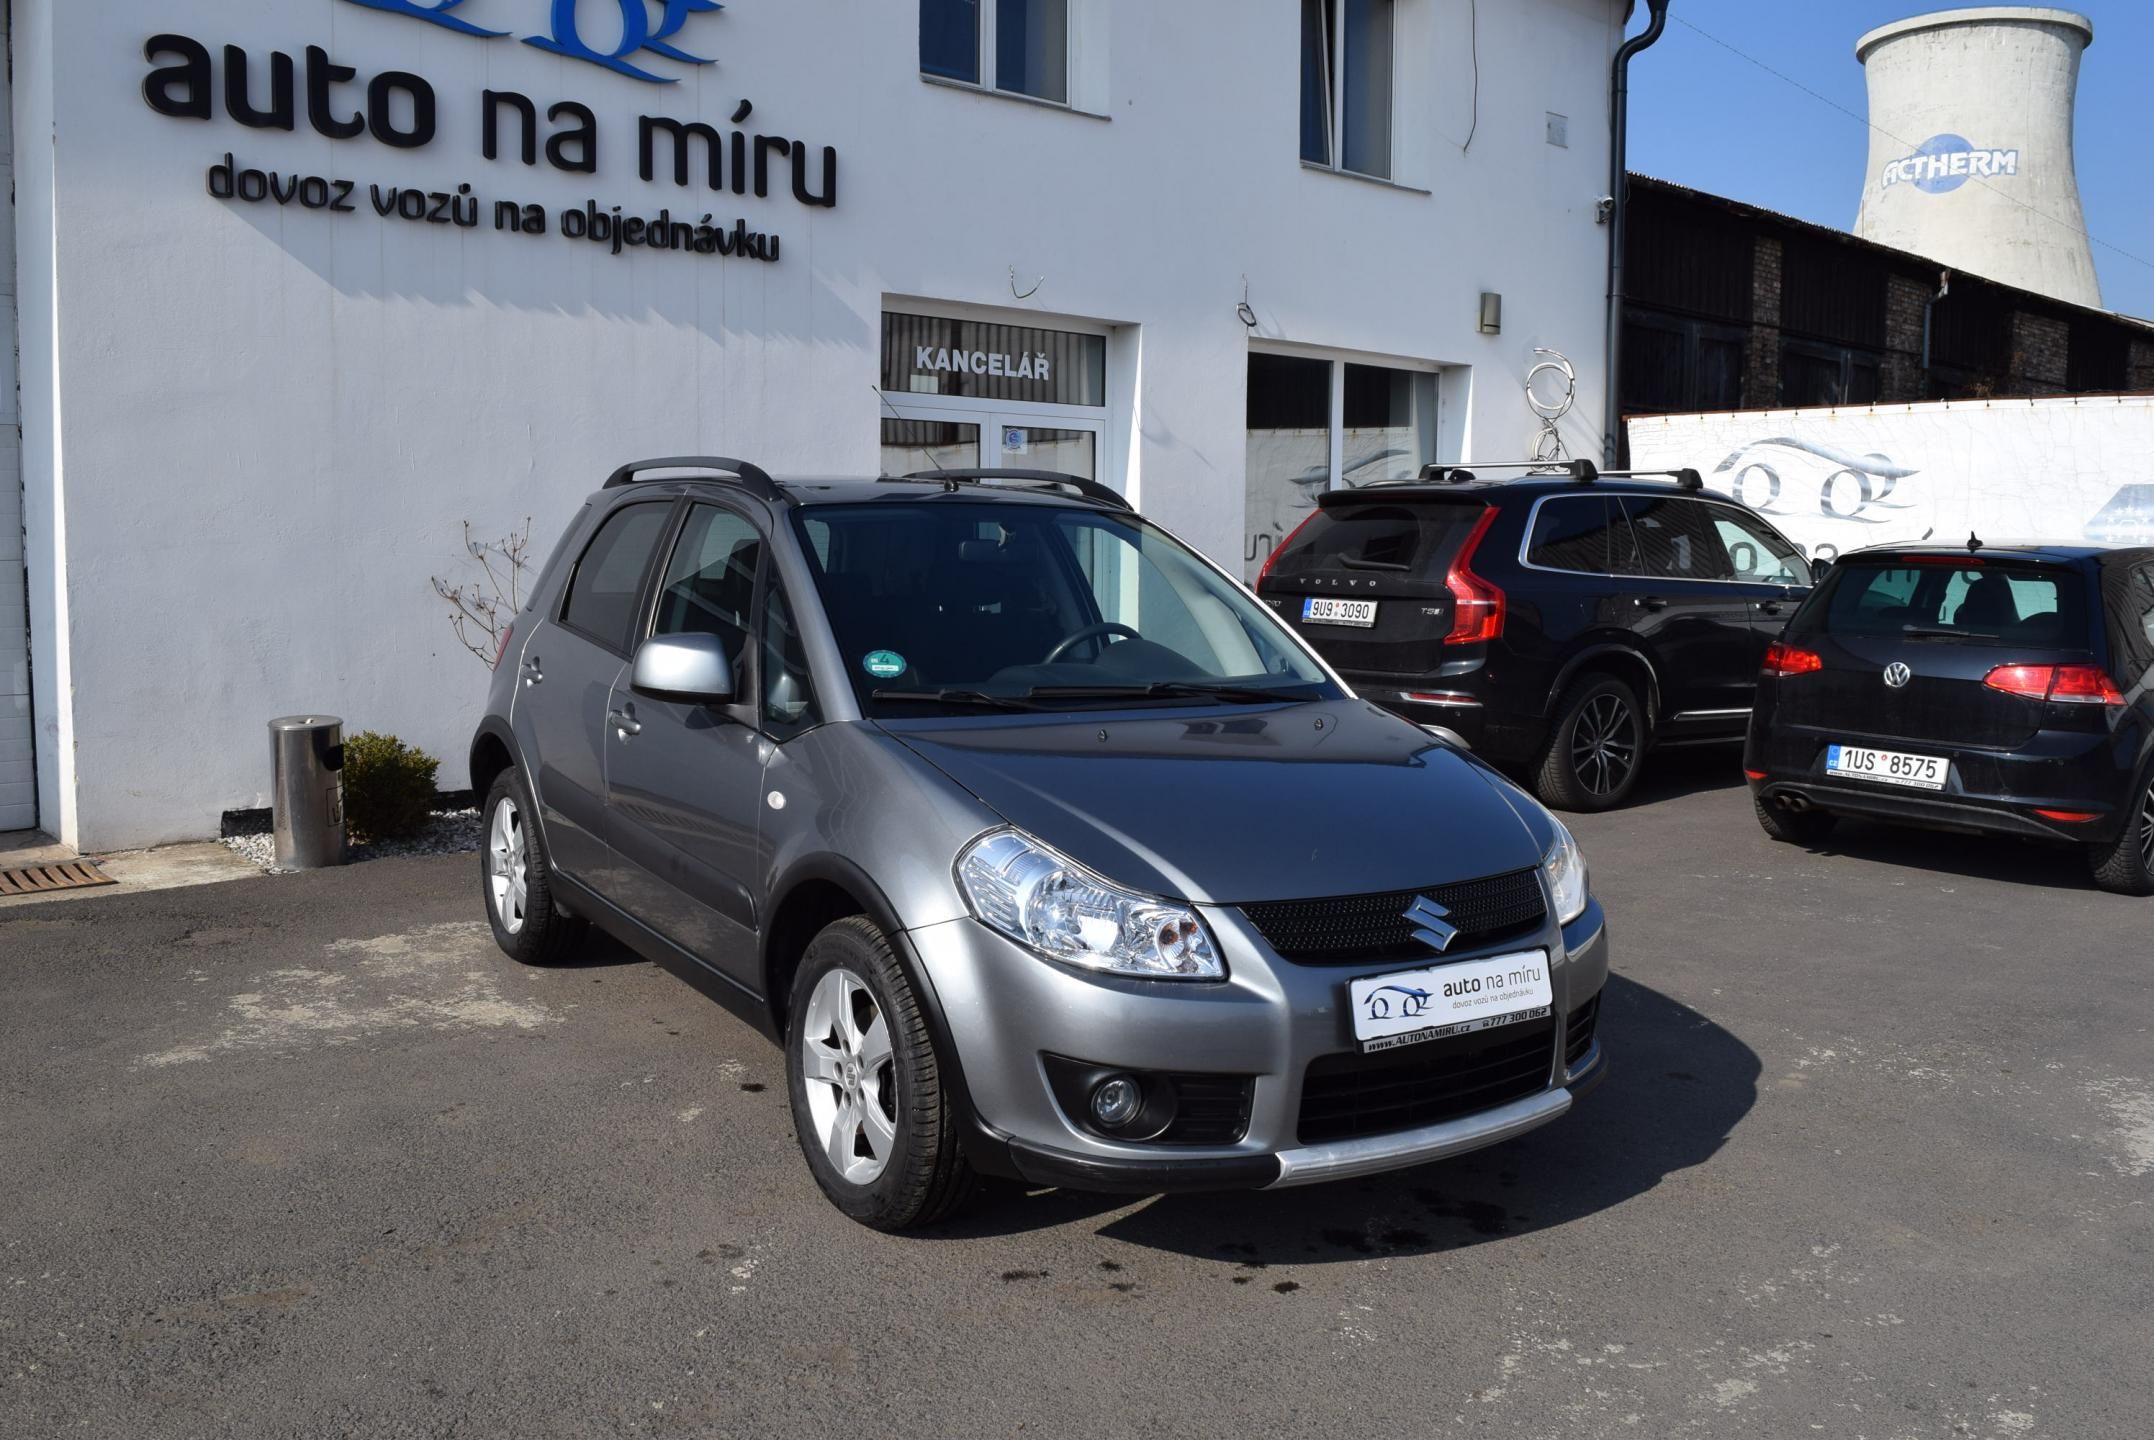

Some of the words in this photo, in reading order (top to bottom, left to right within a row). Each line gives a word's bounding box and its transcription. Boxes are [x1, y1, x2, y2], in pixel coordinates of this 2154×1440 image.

[141, 33, 437, 149] auto
[481, 87, 597, 174] na
[638, 98, 837, 208] míru
[1881, 149, 2018, 190] ACTHERM
[207, 152, 356, 212] dovoz
[370, 182, 478, 228] vozů
[495, 198, 545, 235] na
[560, 206, 780, 262] objednávku
[916, 346, 1049, 381] KANCELÁŘ
[1300, 578, 1377, 587] VOLVO
[1312, 601, 1333, 616] 9U9
[1341, 603, 1370, 619] 3090
[1845, 750, 1876, 771] 1US
[1890, 755, 1938, 779] 8575
[1443, 978, 1481, 997] auto
[1486, 974, 1504, 990] na
[1508, 965, 1541, 986] míru
[1452, 999, 1472, 1009] dovoz
[1490, 994, 1499, 1002] na
[1367, 1025, 1471, 1051] www.AUTONAMIRU.cz
[1490, 1015, 1507, 1027] 777
[1509, 1011, 1528, 1023] 300
[1528, 1007, 1547, 1021] 062
